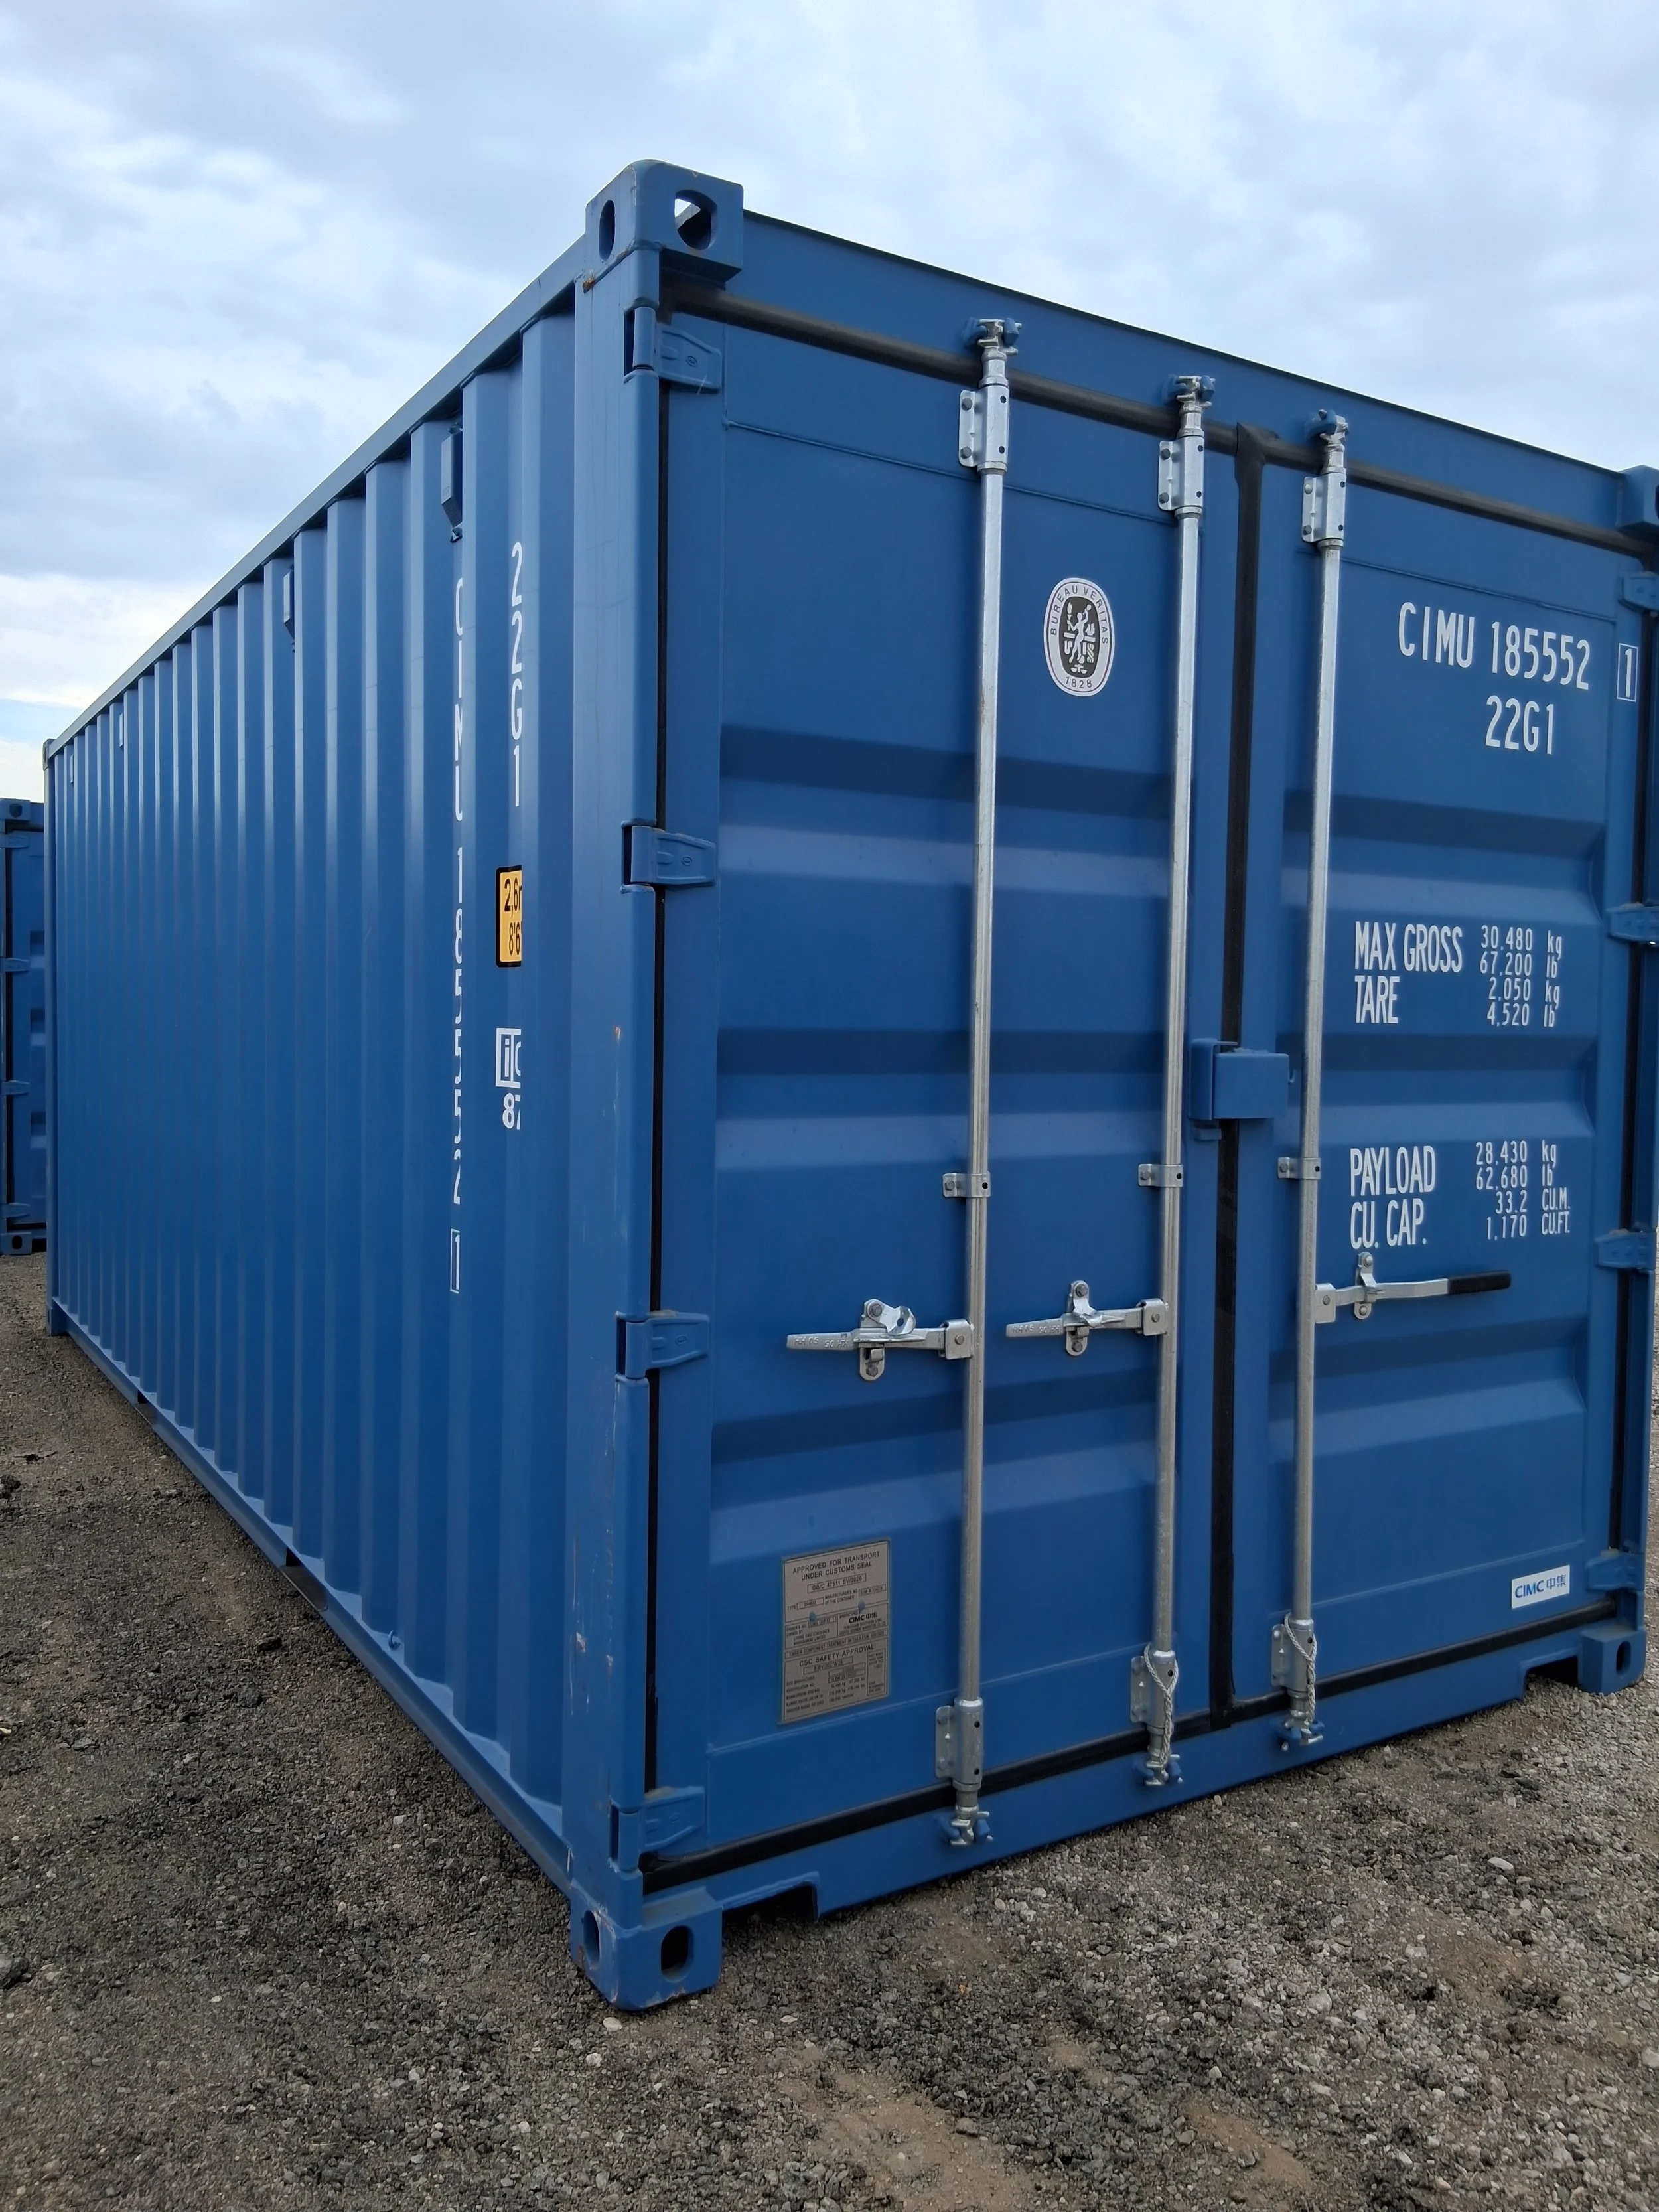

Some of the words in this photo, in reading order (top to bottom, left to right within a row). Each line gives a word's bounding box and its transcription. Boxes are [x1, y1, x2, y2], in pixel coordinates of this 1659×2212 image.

[1050, 585, 1078, 636] BUREAU
[1083, 587, 1108, 644] VERITAS
[1398, 601, 1475, 668] CIMU
[1491, 621, 1591, 690] 185552
[1624, 648, 1632, 698] 1
[511, 541, 522, 807] 22G1
[1066, 676, 1092, 689] 1828
[1485, 694, 1554, 755] 22G1
[1354, 921, 1396, 971] MAX
[1403, 923, 1463, 973] GROSS
[1547, 930, 1562, 960] kg
[1546, 955, 1558, 978] lb
[1354, 975, 1400, 1024] TARE
[1544, 980, 1560, 1009] kg
[1543, 1004, 1555, 1028] lb
[1350, 1145, 1436, 1197] PAYLOAD
[1542, 1139, 1557, 1167] kg
[1542, 1163, 1553, 1187] lb
[1350, 1201, 1379, 1250] CU.
[1386, 1198, 1427, 1247] CAP.
[1495, 1189, 1527, 1215] 33.2
[792, 1561, 827, 1574] APPROVED
[829, 1557, 842, 1568] FOR
[844, 1550, 881, 1564] TRANSPORT
[801, 1570, 823, 1581] UNDER
[825, 1564, 855, 1576] CUSTOMS
[857, 1560, 873, 1570] SEAL
[1514, 1580, 1544, 1599] CIMC
[849, 1615, 865, 1623] CIMC
[816, 1652, 840, 1664] SAFETY
[841, 1643, 875, 1657] APPROVAL
